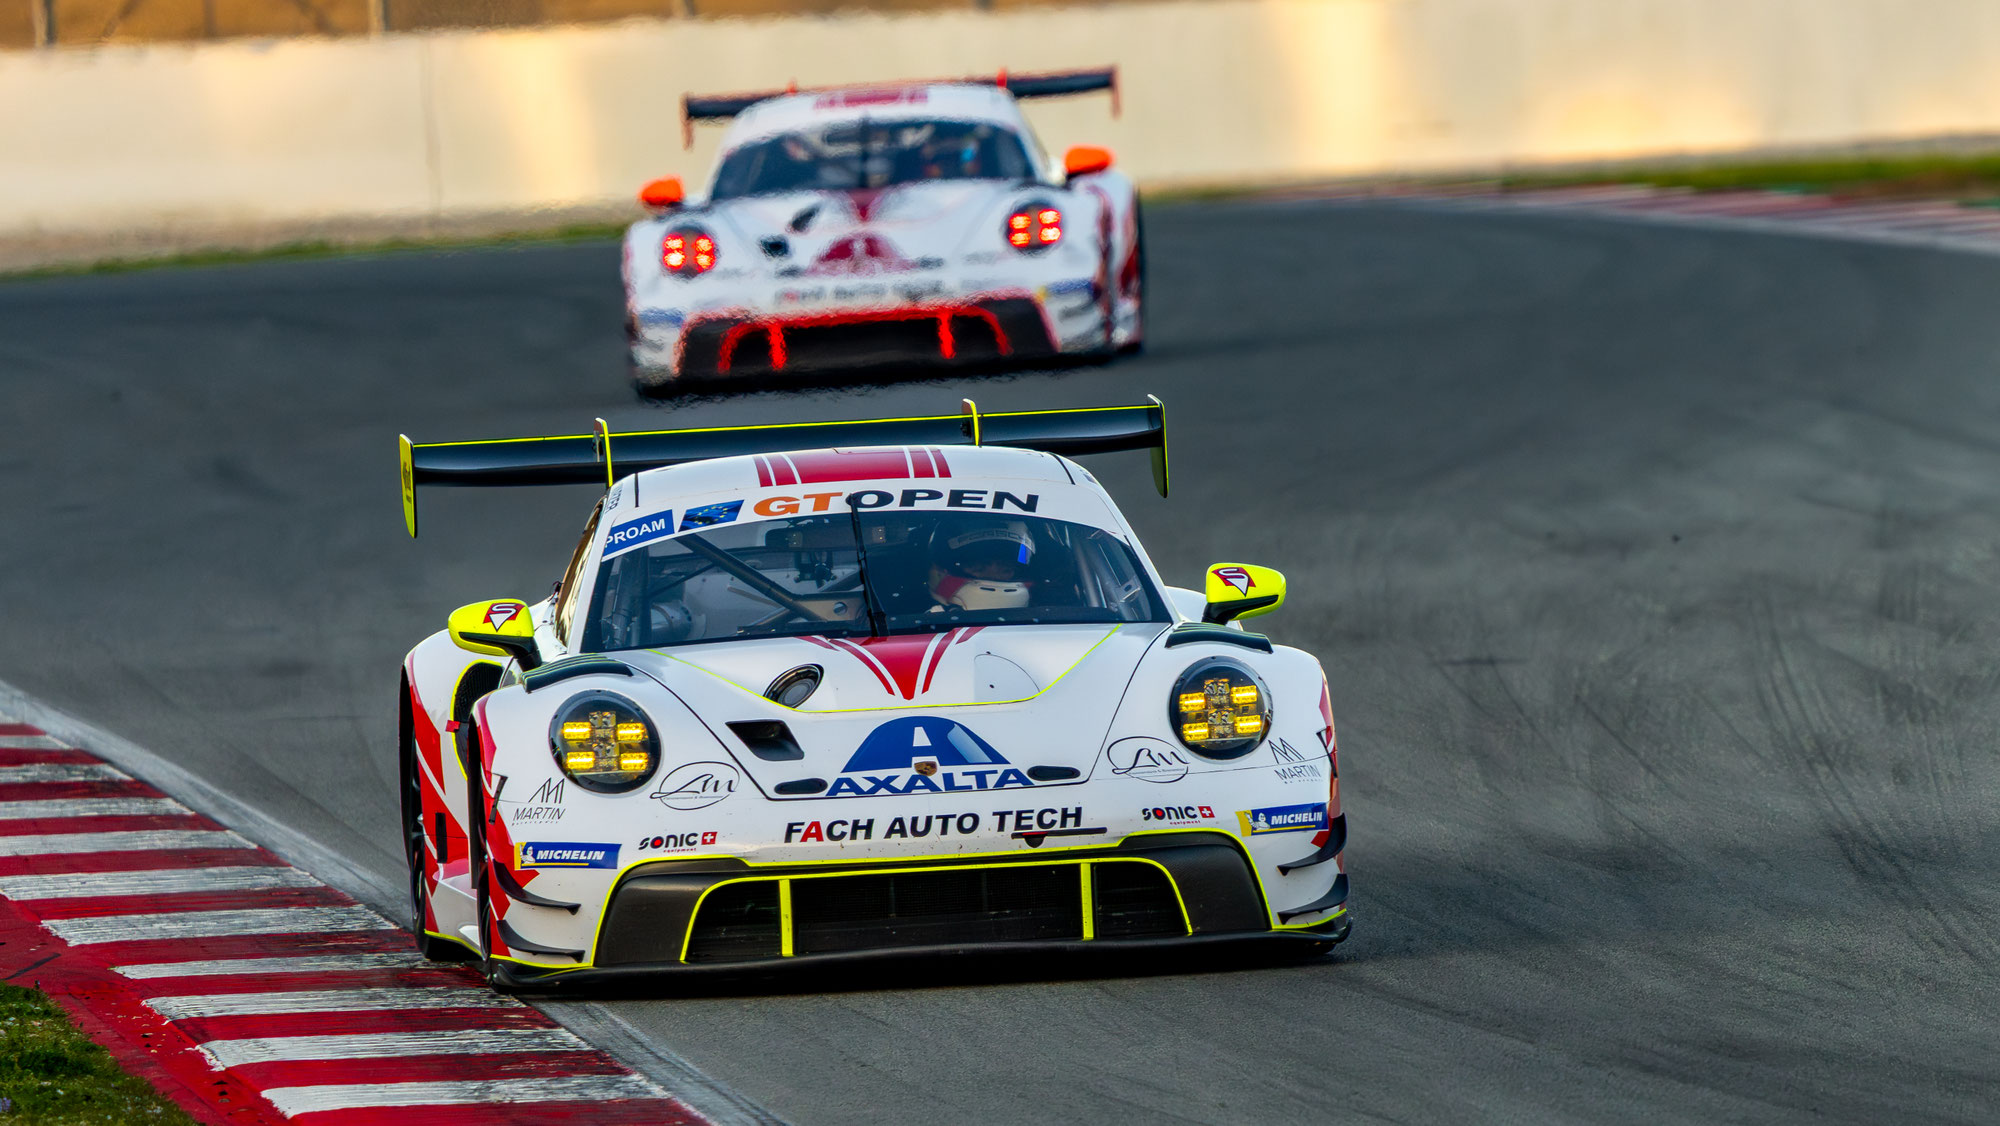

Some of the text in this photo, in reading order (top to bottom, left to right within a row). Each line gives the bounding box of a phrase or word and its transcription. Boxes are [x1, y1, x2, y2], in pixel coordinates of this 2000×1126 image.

[1274, 765, 1321, 780] MARTIN
[825, 768, 1035, 796] AXALTA
[512, 807, 566, 821] MARTIN
[1271, 812, 1323, 825] MICHELIN
[784, 806, 1082, 843] FACH AUTO TECH
[536, 850, 605, 860] MICHELIN
